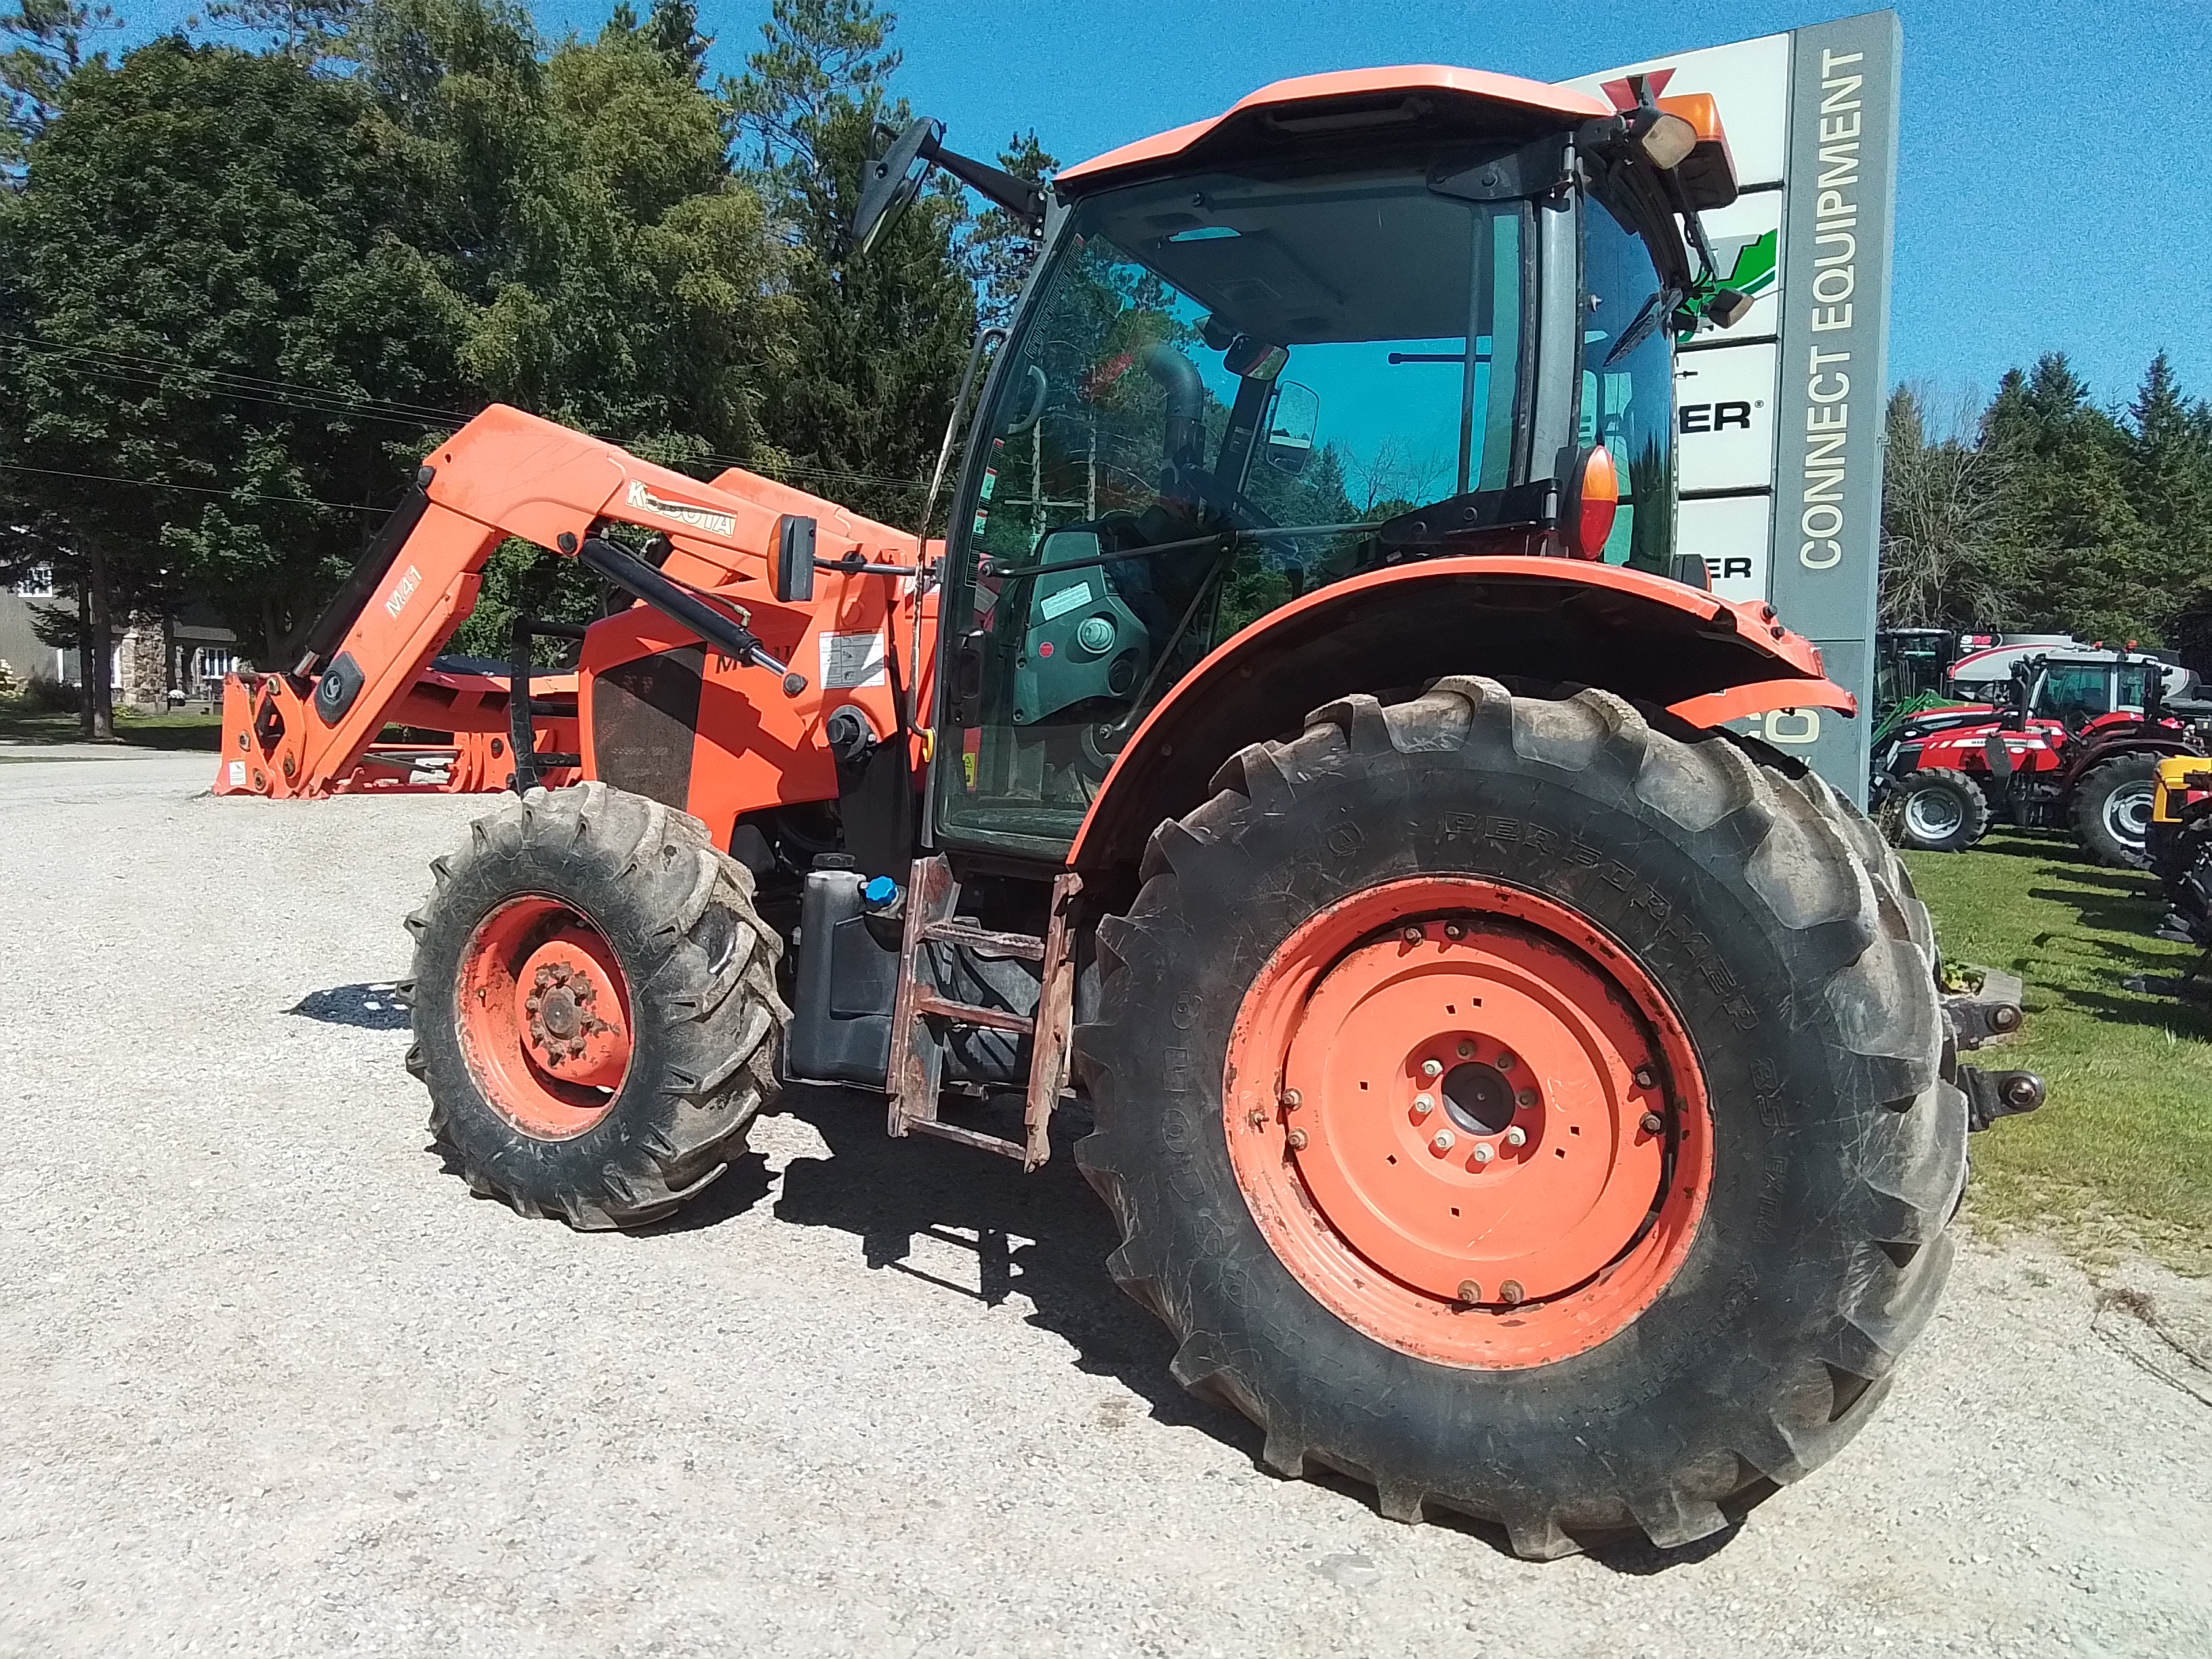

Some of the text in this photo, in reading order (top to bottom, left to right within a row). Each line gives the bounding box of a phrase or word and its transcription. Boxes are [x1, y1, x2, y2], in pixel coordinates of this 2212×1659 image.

[1799, 48, 1864, 570] CONNECT EQUIPMENT
[384, 564, 422, 619] M41
[1443, 811, 1761, 1034] PERFORMER
